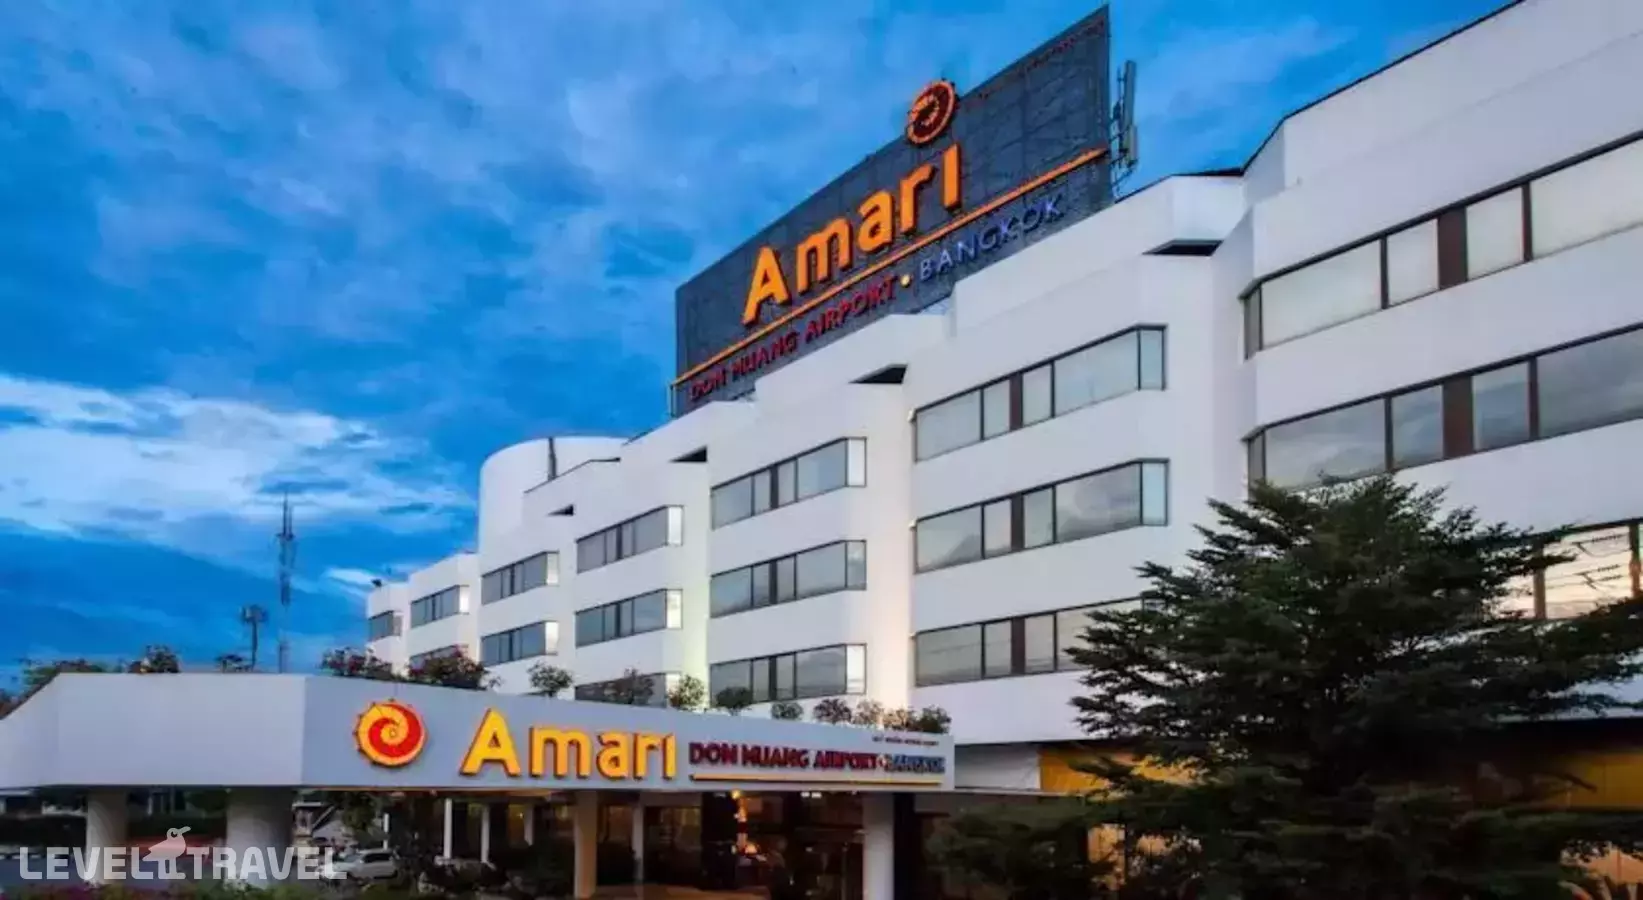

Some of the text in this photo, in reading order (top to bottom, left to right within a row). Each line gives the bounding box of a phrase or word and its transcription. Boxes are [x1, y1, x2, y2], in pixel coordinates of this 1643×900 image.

[741, 142, 964, 327] Amari
[805, 275, 899, 344] AIRPORT
[920, 192, 1065, 281] BANGKOK
[459, 706, 676, 780] Amari
[689, 742, 738, 765] DON
[741, 744, 809, 768] MUANG
